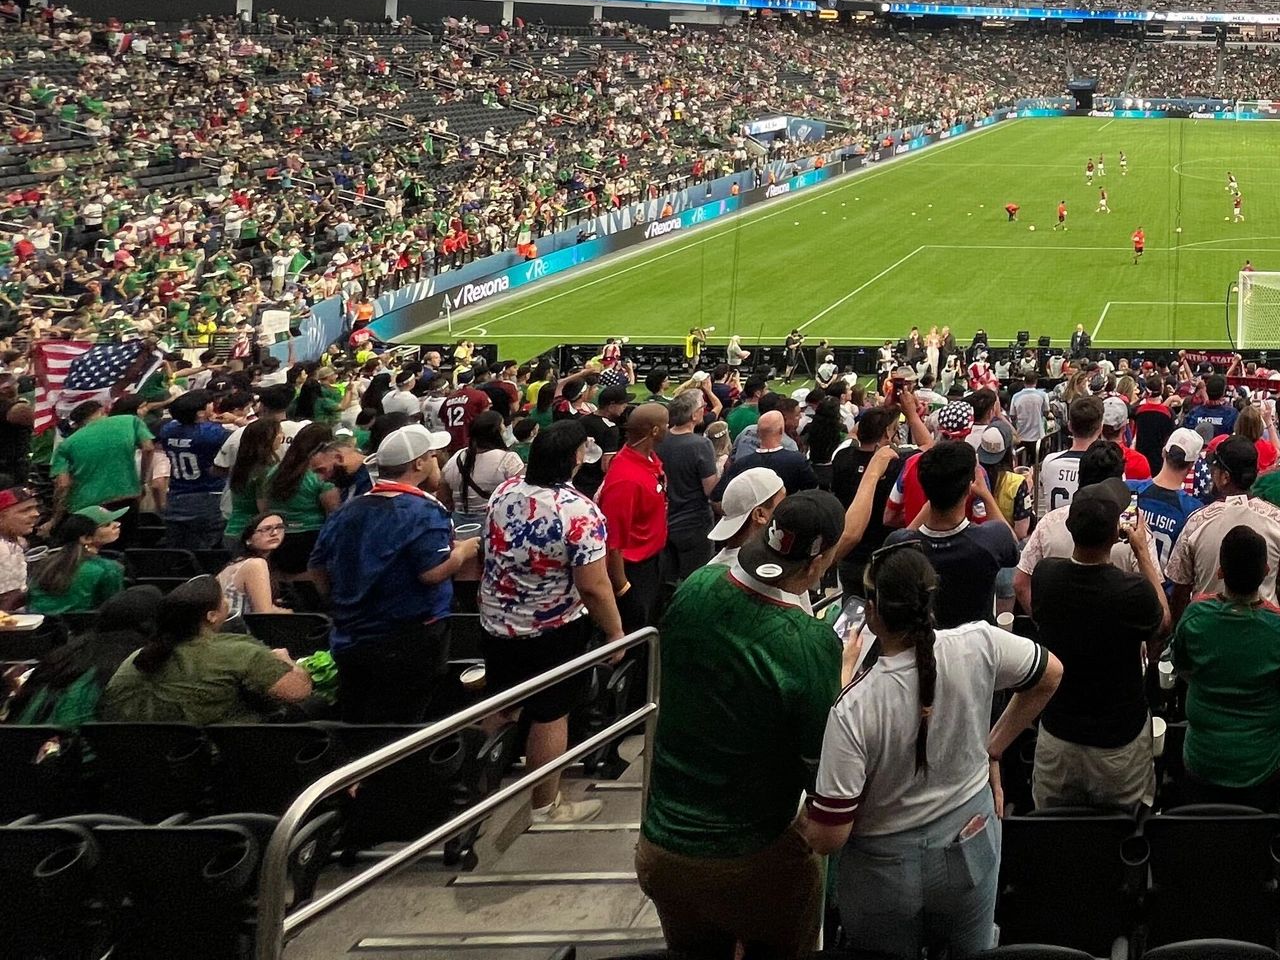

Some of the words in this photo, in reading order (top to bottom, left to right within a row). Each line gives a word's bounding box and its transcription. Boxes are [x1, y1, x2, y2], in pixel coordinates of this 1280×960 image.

[651, 217, 682, 237] Rexona
[463, 275, 509, 305] Rexona
[446, 406, 465, 427] 12
[167, 450, 201, 480] 10
[1143, 509, 1177, 533] ULISIC
